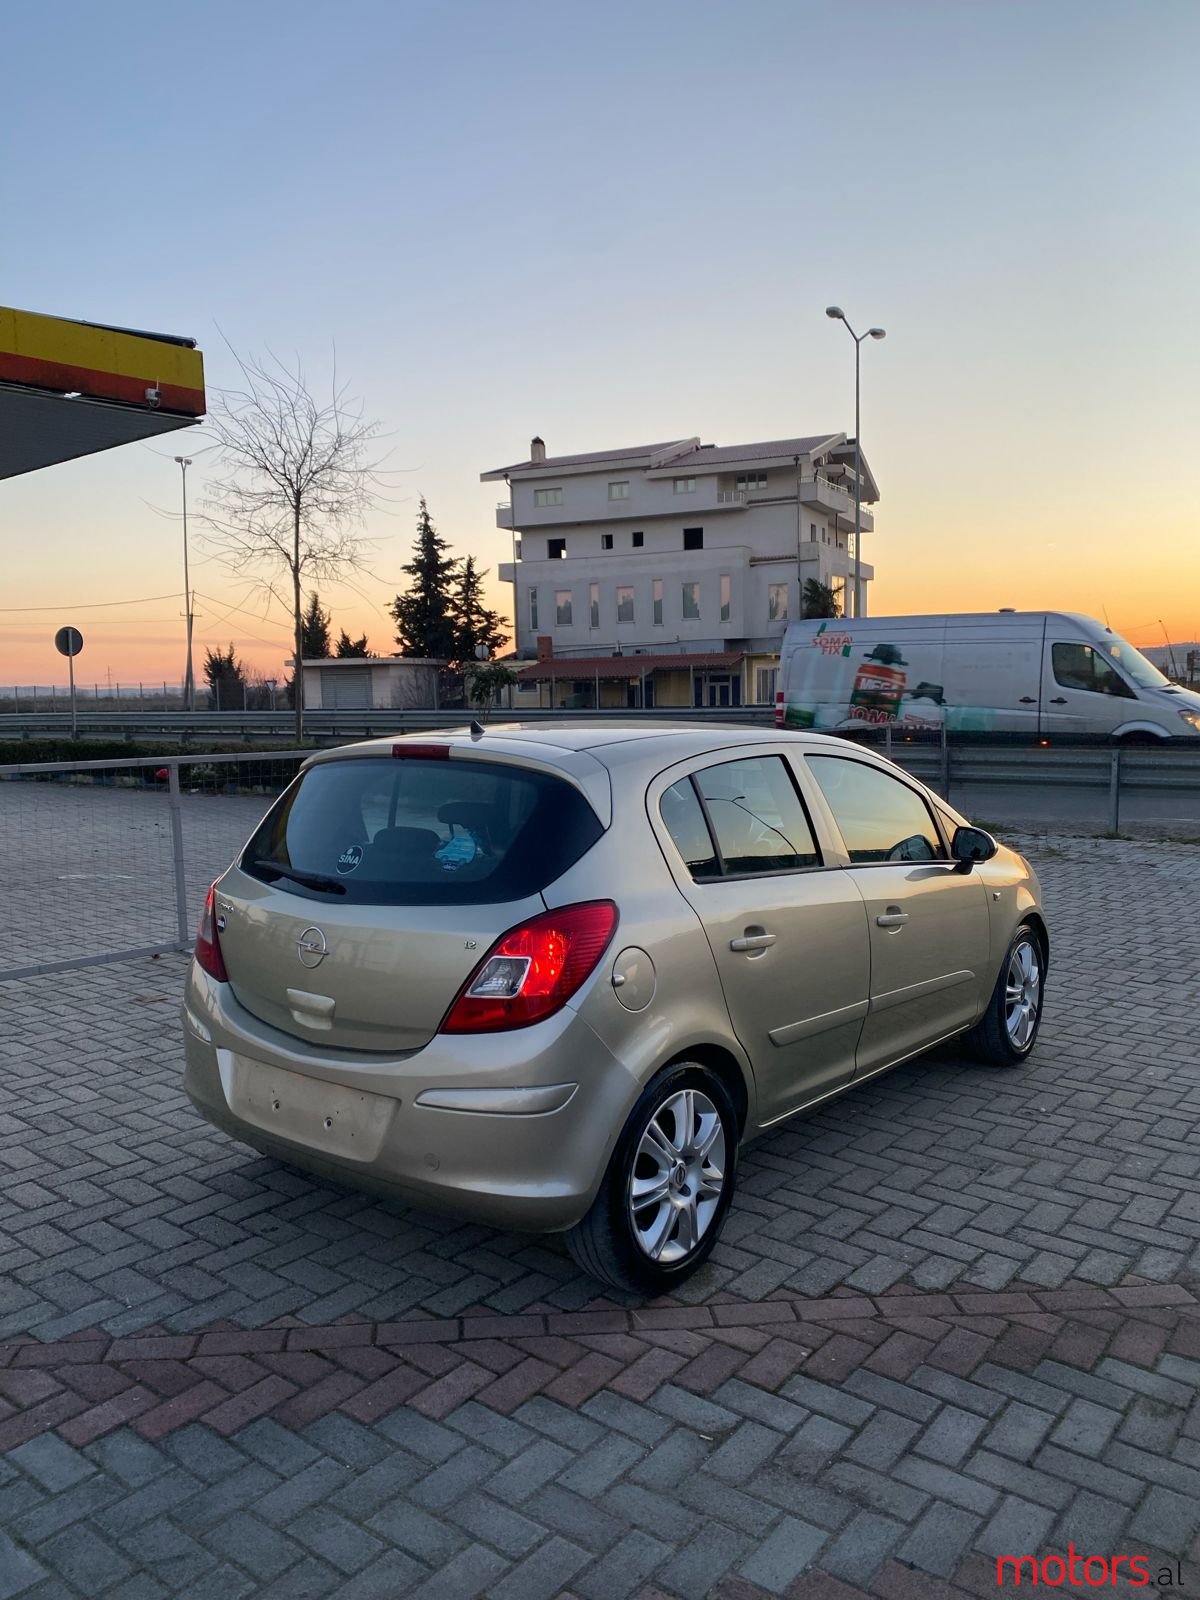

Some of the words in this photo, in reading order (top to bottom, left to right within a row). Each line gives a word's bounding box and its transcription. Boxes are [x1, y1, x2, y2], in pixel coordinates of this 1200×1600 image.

[812, 636, 850, 647] SOMA
[821, 645, 840, 656] FIX
[338, 854, 360, 865] SINA
